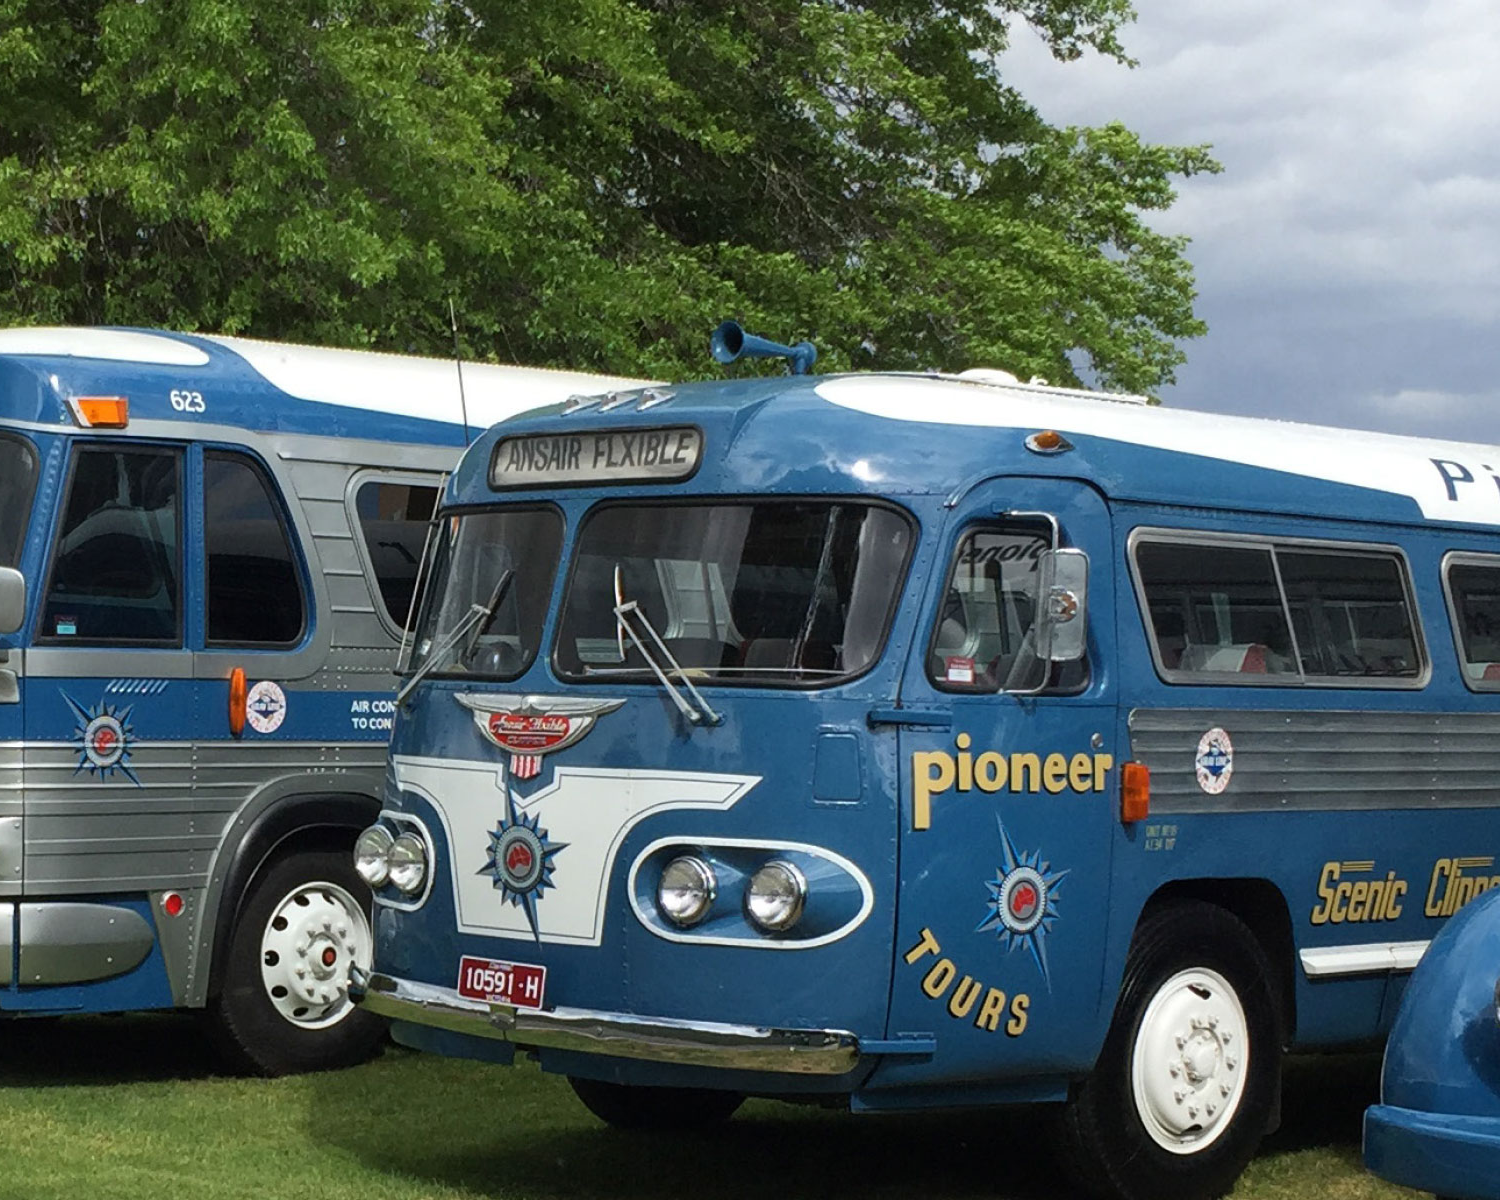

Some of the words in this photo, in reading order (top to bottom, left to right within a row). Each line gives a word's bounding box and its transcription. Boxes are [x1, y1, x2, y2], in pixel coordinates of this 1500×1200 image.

[170, 390, 206, 413] 623
[504, 437, 582, 472] ANSAIR
[593, 433, 694, 469] FLXIBLE
[350, 700, 370, 712] AIR
[351, 717, 368, 729] TO
[913, 732, 1113, 829] pioneer
[1311, 861, 1408, 925] Scenic
[905, 928, 1031, 1036] TOURS
